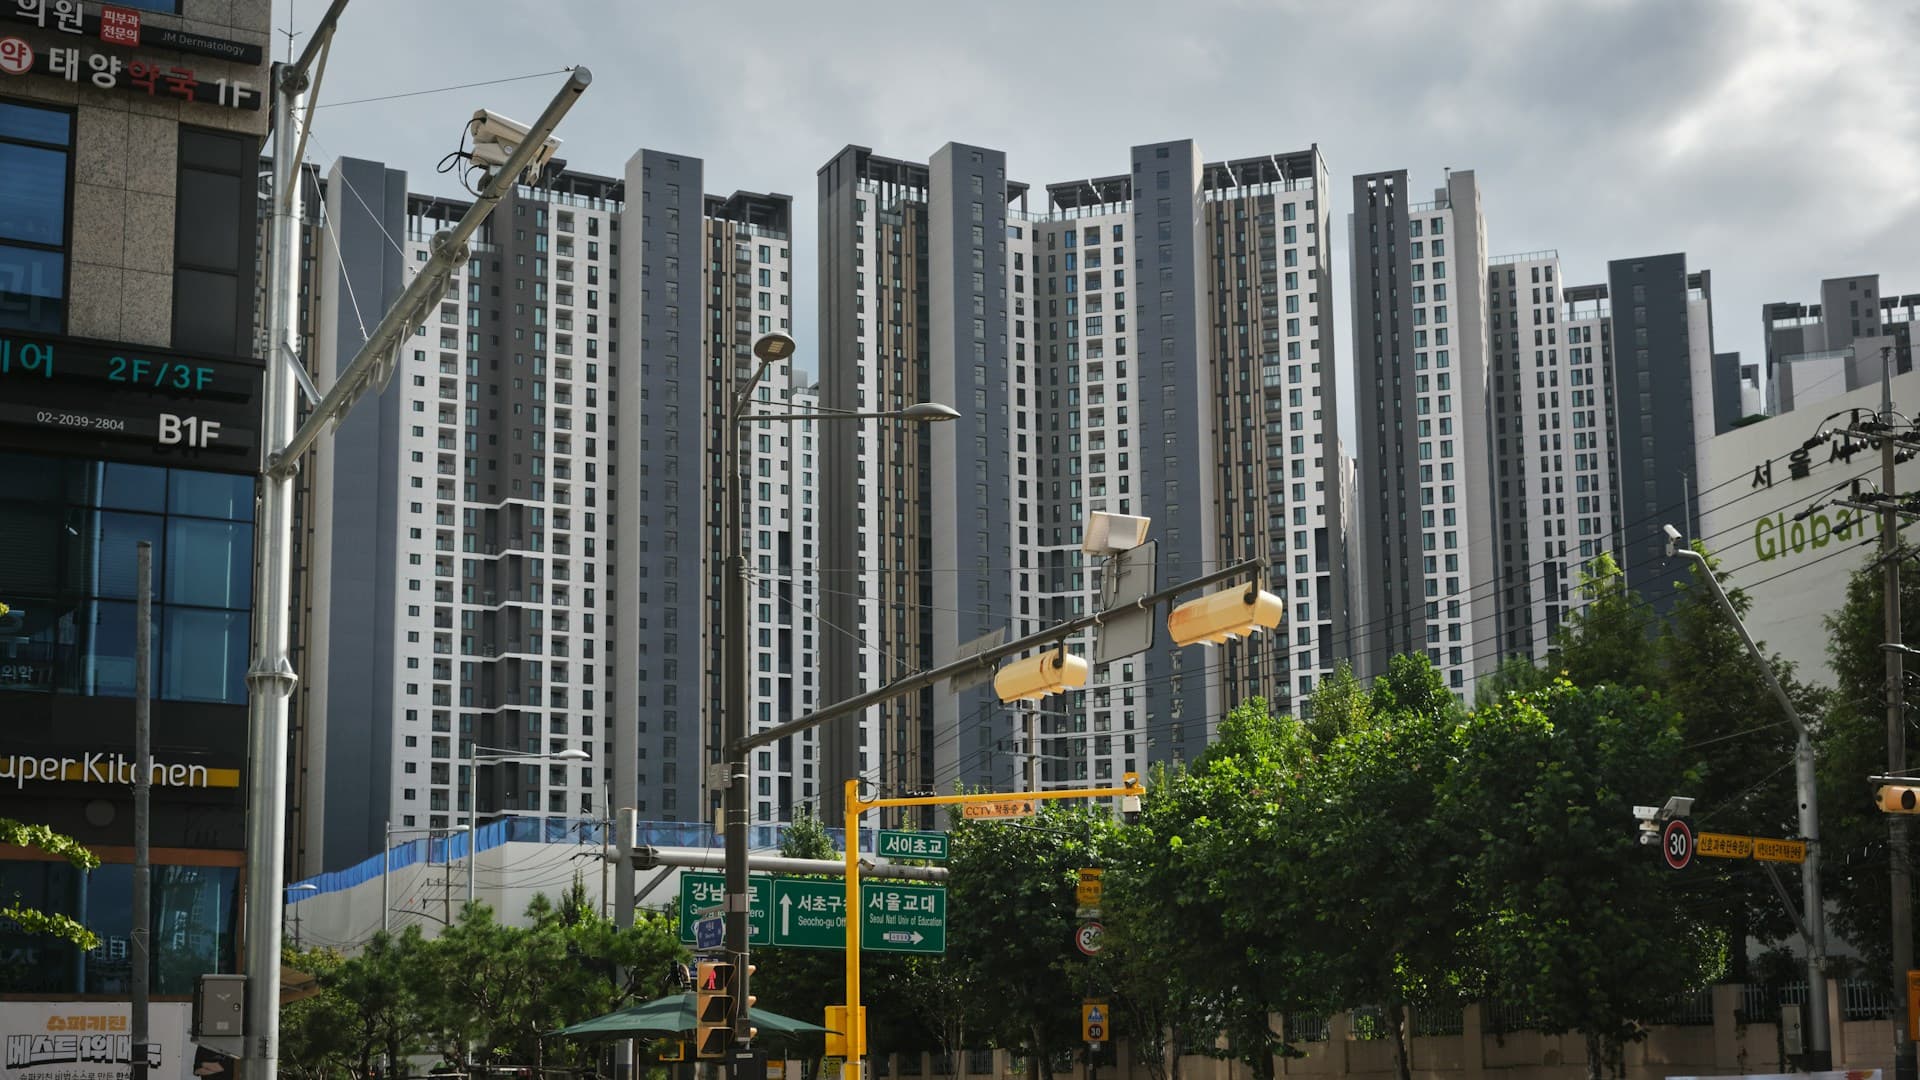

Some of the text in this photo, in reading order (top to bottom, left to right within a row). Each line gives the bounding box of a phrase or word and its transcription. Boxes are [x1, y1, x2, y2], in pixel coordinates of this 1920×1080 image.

[104, 10, 139, 27] 피부과
[103, 25, 137, 42] 전문의
[161, 32, 245, 56] JM Dermatology
[215, 78, 251, 108] 1F
[108, 356, 215, 391] 2F/3F
[37, 411, 221, 448] 02-2039-2804 B1F
[1755, 508, 1865, 563] Global
[965, 806, 993, 818] CCTV
[886, 836, 944, 855] 서이초교
[1670, 833, 1686, 856] 30
[692, 881, 760, 903] 강남로
[869, 893, 934, 912] 서울교대
[798, 914, 835, 930] Seocho-gu
[869, 913, 885, 924] Seoul
[898, 916, 910, 926] Univ
[911, 917, 917, 926] of
[918, 916, 943, 928] Education
[6, 1035, 77, 1069] 베스트
